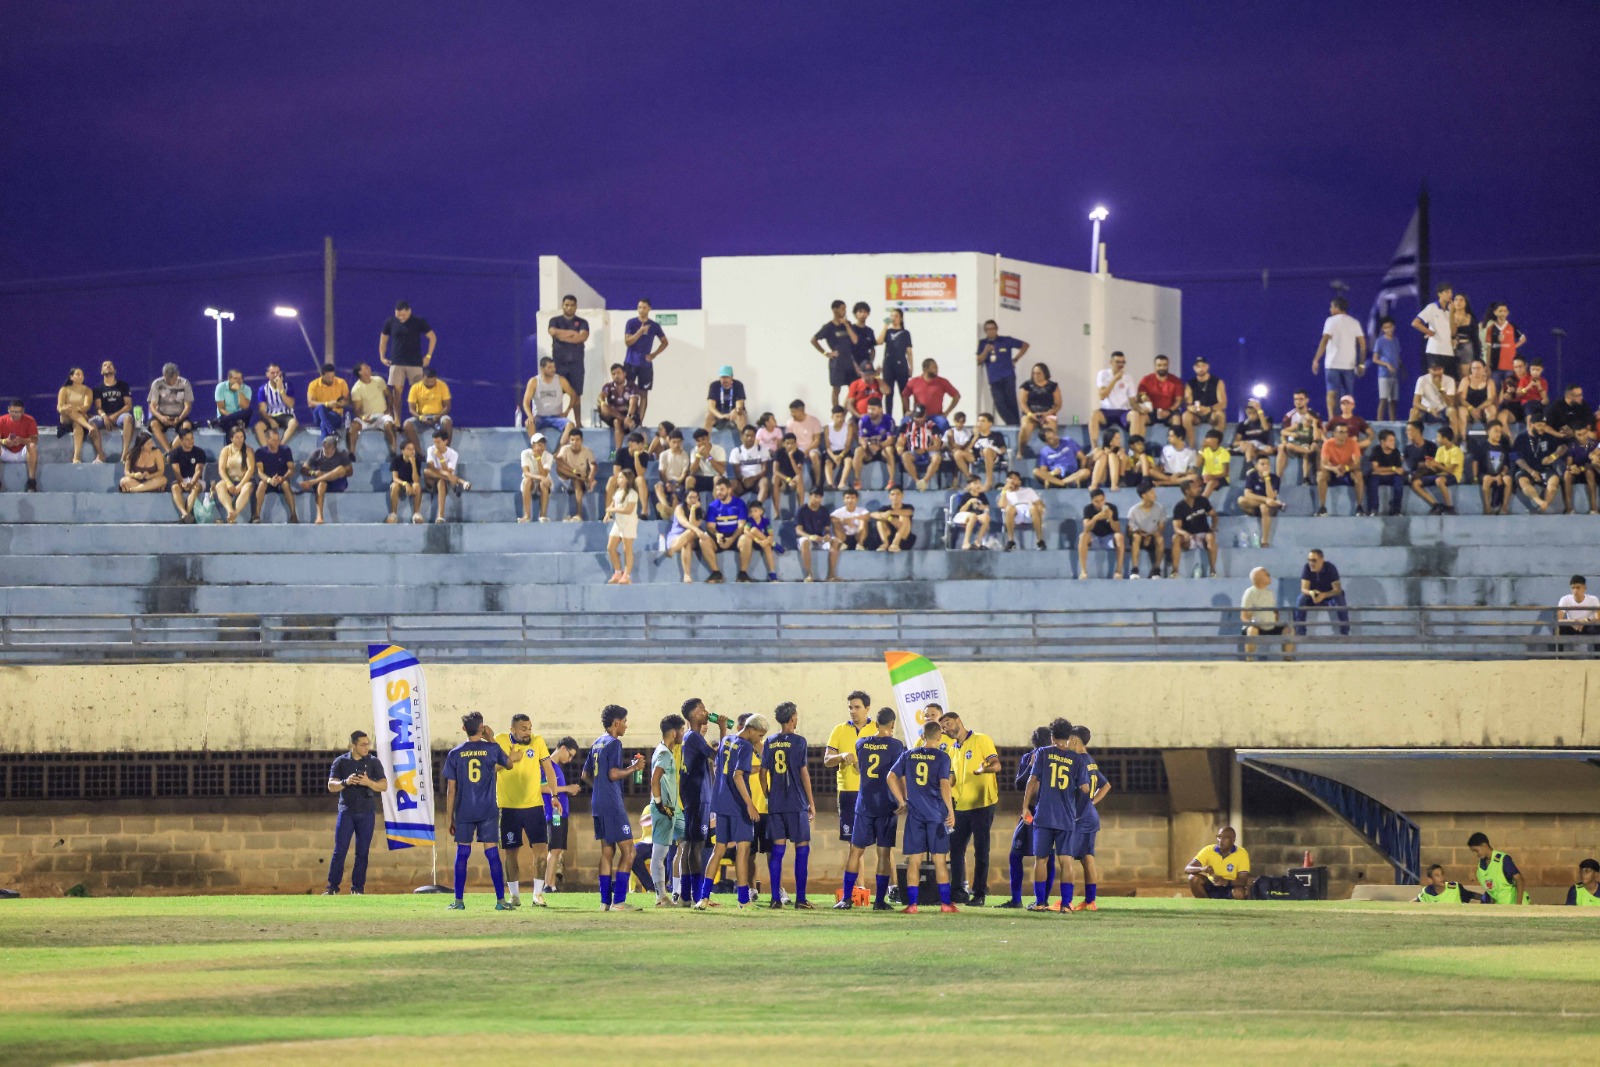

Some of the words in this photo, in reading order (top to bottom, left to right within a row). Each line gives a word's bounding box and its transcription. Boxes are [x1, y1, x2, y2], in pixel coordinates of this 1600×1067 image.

[901, 281, 947, 289] BANHEIRO
[901, 289, 944, 297] FEMININO
[904, 689, 939, 704] ESPORTE
[386, 678, 418, 811] PALMAS
[412, 685, 426, 802] PREFEITURA
[468, 758, 481, 783] 6
[774, 749, 787, 774] 8
[866, 753, 880, 779] 2
[915, 761, 929, 786] 9
[1049, 763, 1070, 789] 15
